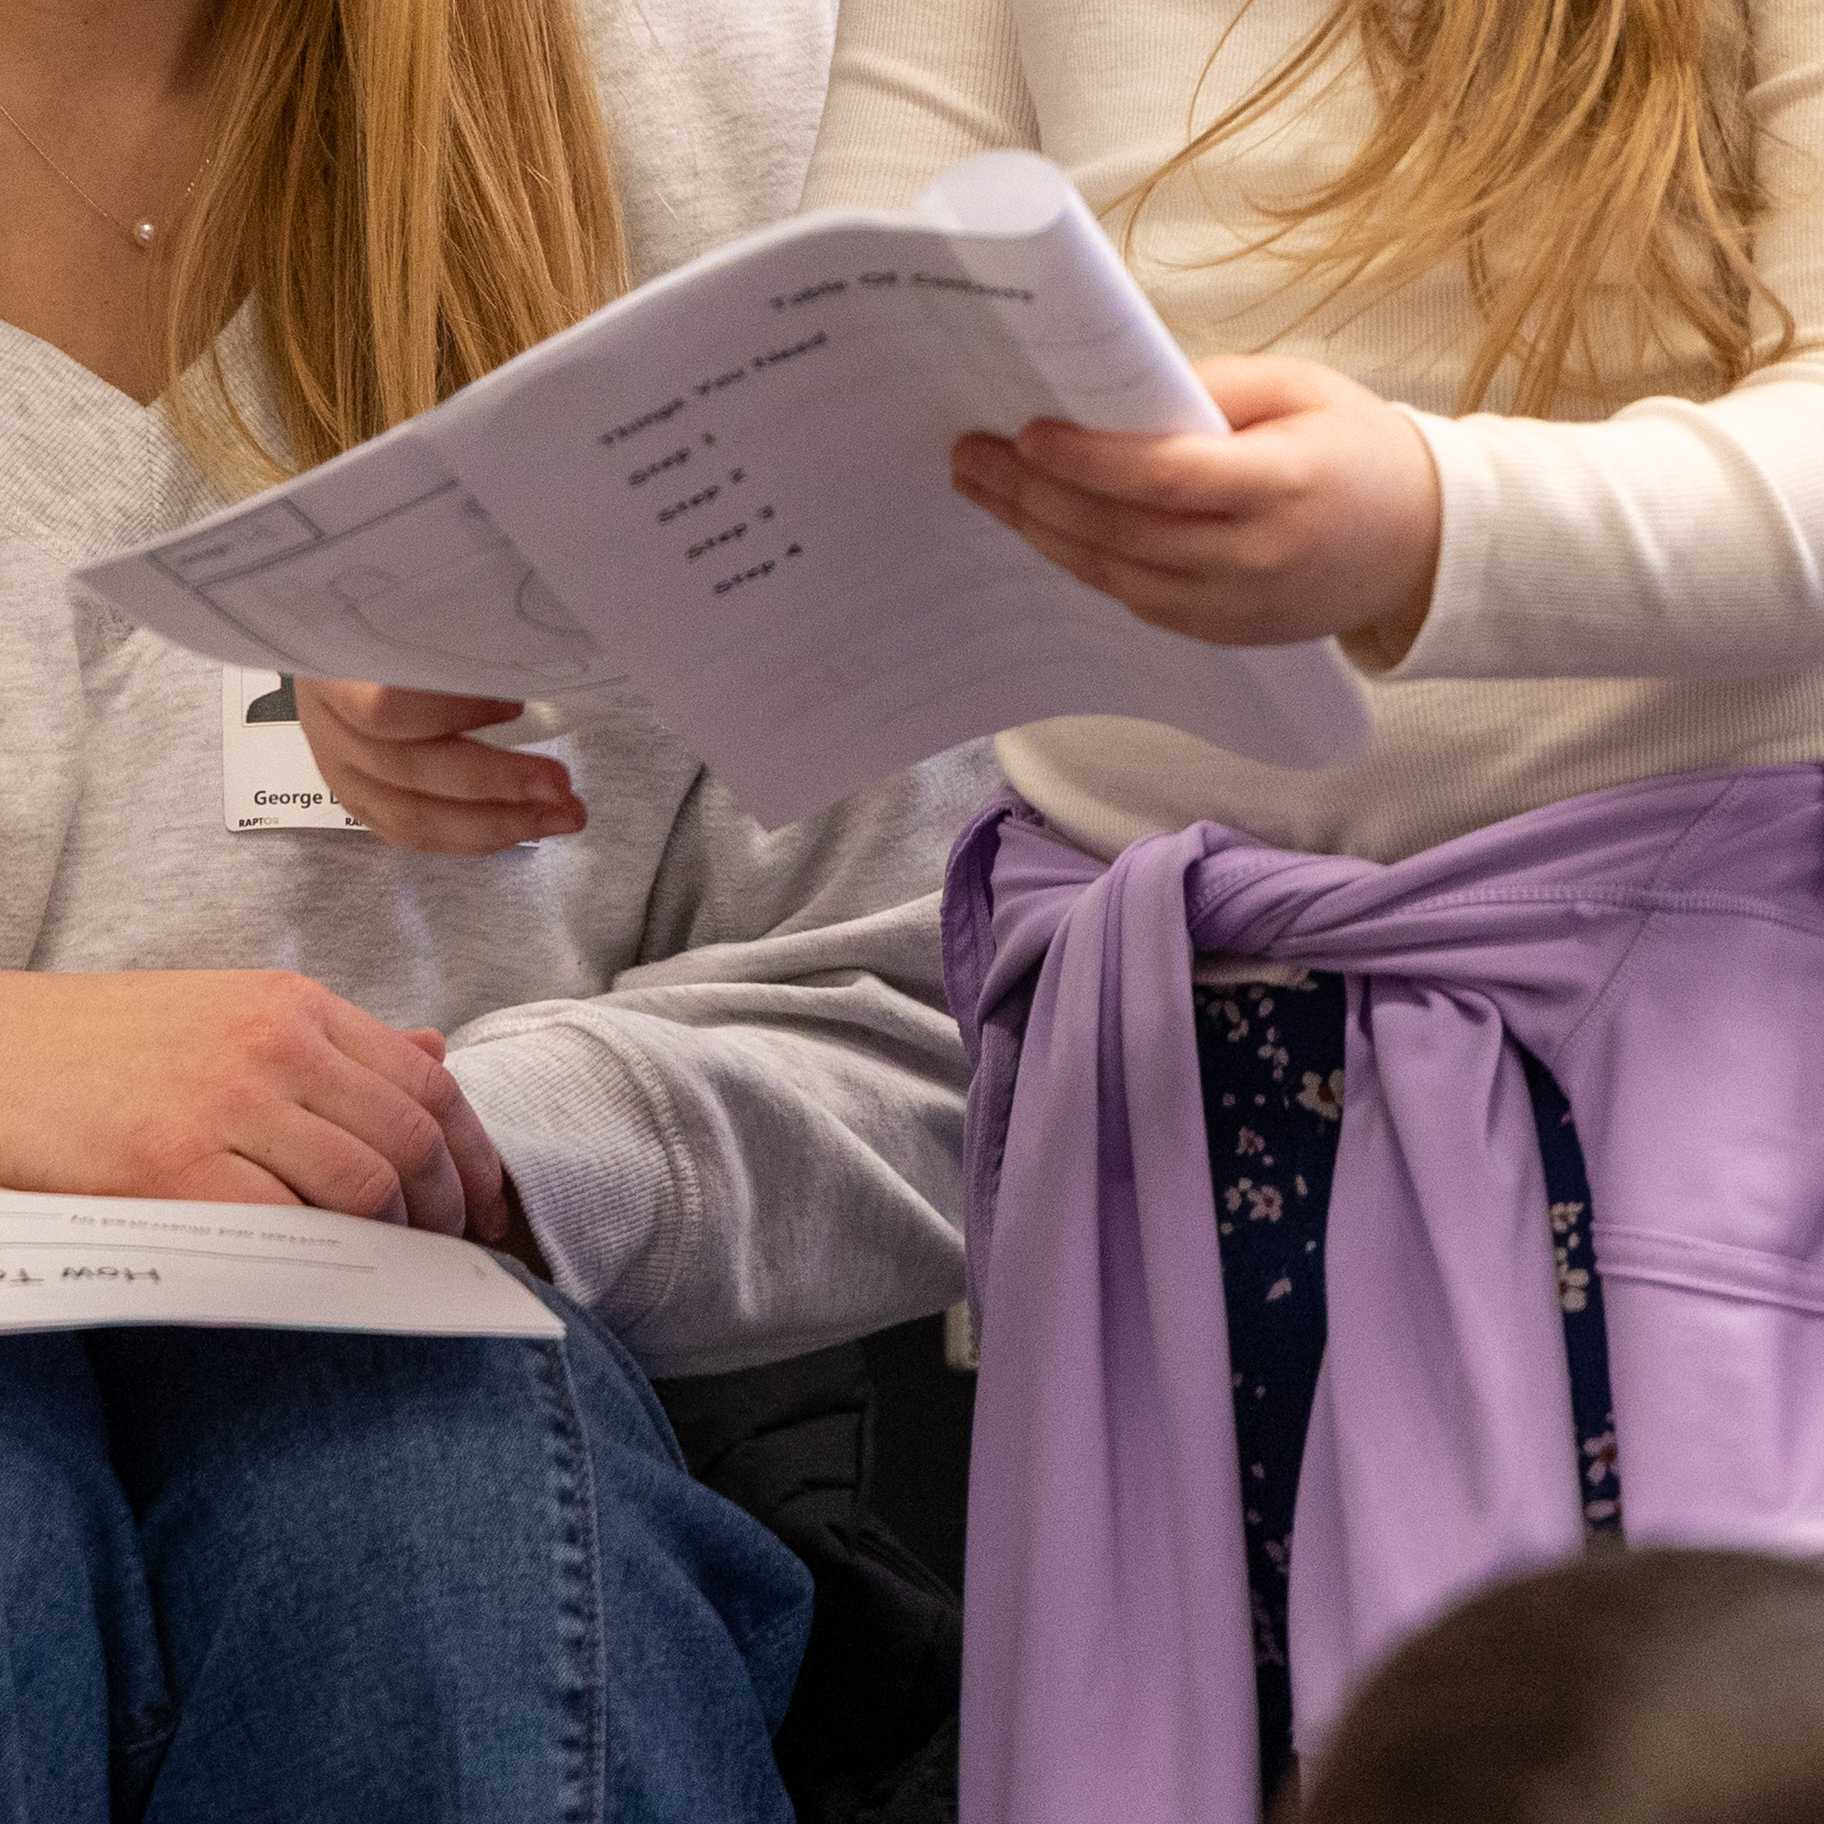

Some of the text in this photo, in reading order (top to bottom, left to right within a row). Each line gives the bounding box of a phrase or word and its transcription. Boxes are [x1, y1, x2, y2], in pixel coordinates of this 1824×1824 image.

[629, 446, 692, 487] Step
[657, 484, 720, 525] Step
[686, 521, 748, 562] Step
[714, 559, 776, 597] Step
[254, 790, 323, 808] George
[60, 1264, 160, 1289] How
